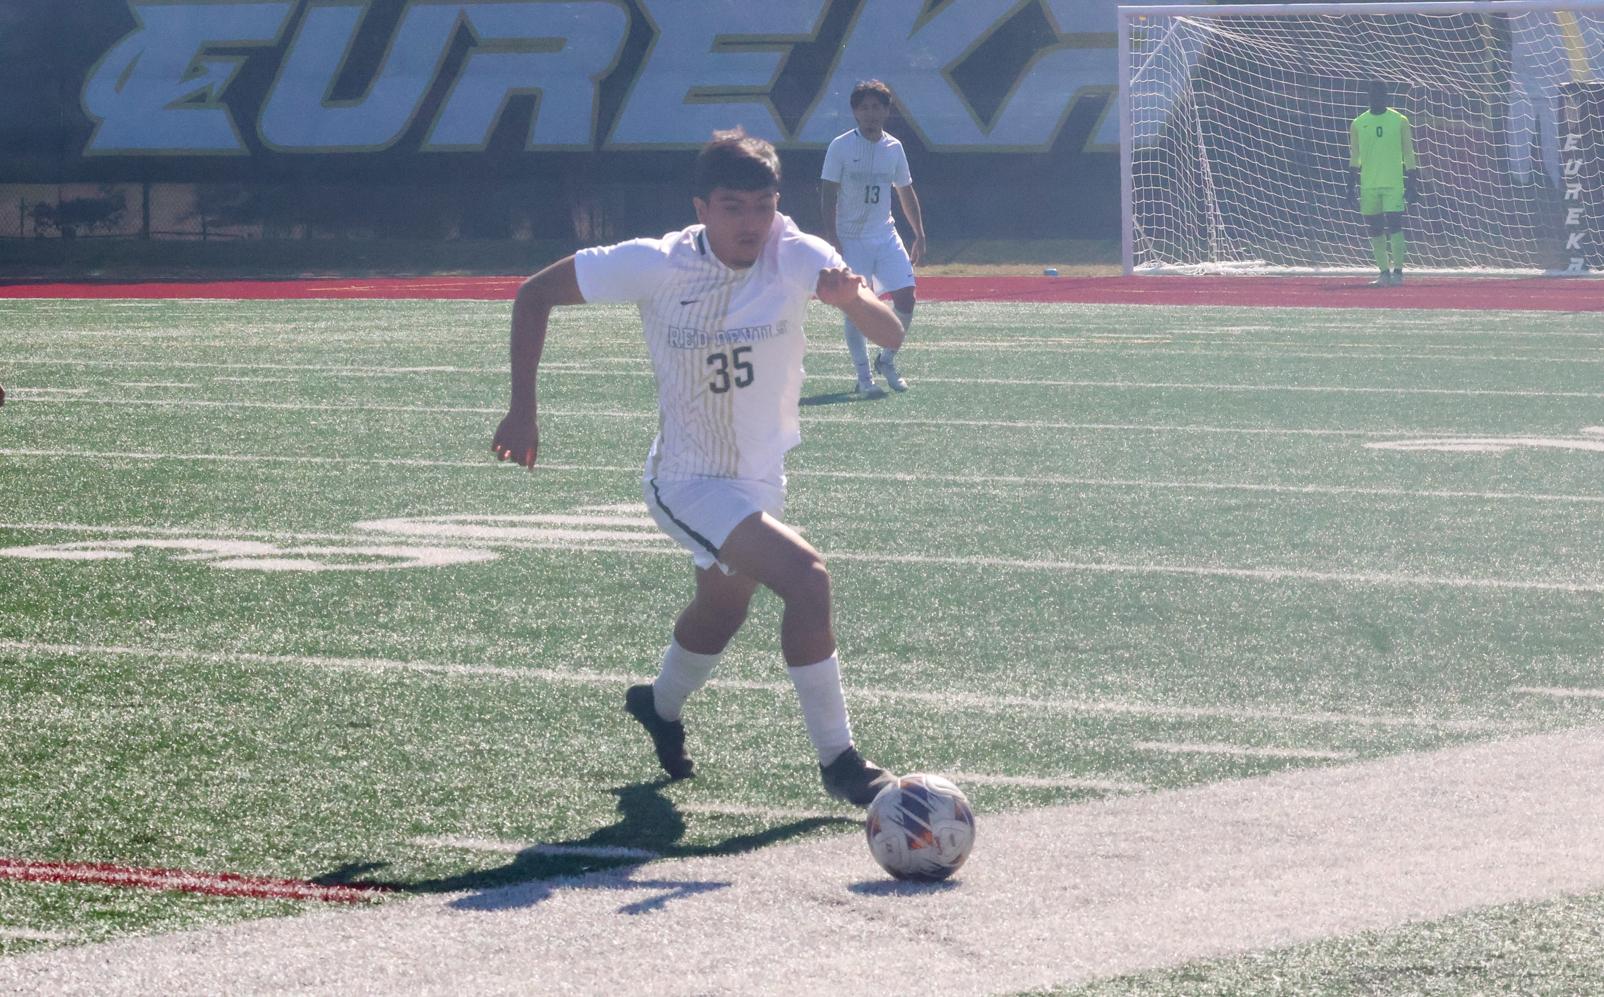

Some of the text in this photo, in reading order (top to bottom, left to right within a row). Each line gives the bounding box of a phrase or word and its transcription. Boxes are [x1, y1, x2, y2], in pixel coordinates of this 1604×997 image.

[1375, 126, 1383, 138] 0
[864, 185, 880, 204] 13
[1564, 133, 1586, 273] EUREKA
[668, 325, 708, 349] RED
[707, 346, 754, 394] 35
